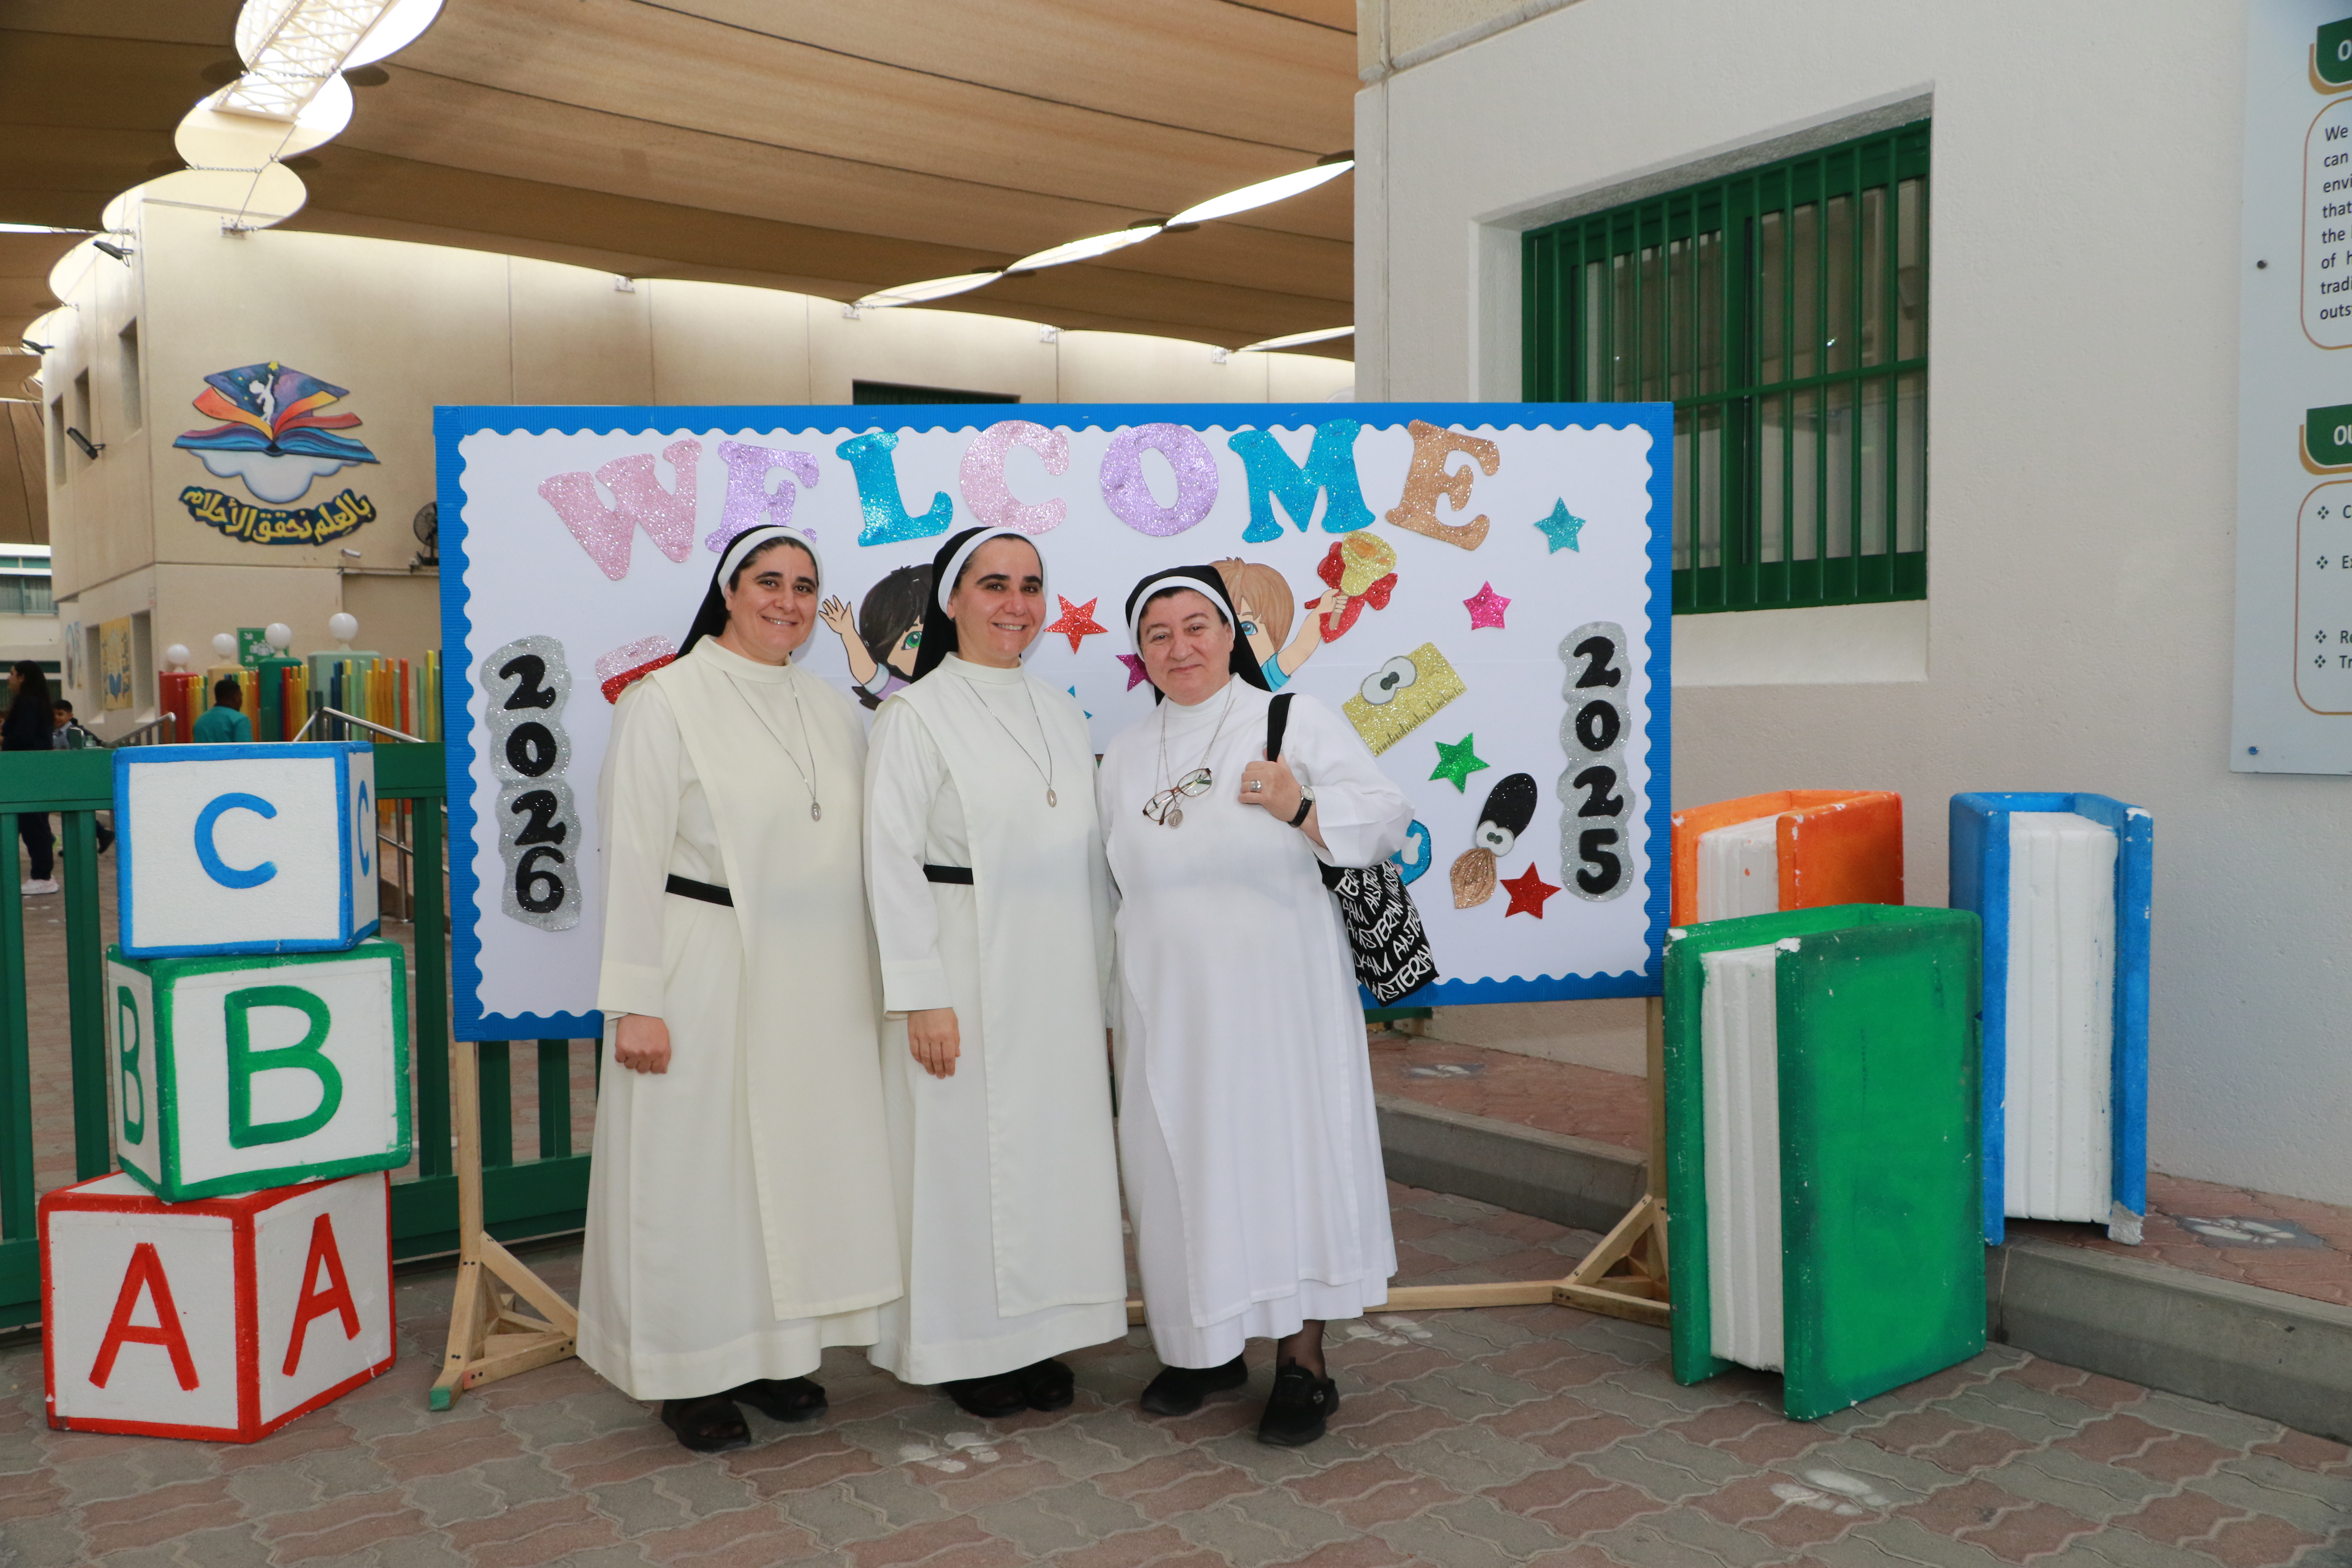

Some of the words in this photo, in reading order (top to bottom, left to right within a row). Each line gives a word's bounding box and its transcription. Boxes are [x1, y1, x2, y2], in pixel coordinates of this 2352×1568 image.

[2324, 152, 2349, 167] can
[2325, 125, 2348, 141] We
[2322, 200, 2352, 218] that
[2322, 228, 2345, 244] the
[2321, 253, 2336, 269] of
[2320, 304, 2352, 319] outs
[252, 510, 312, 543] نحقق
[538, 418, 1501, 581] WELCOME
[499, 654, 567, 913] 2026
[1574, 636, 1623, 894] 2025
[195, 792, 278, 889] C
[358, 780, 370, 877] C
[117, 986, 145, 1145] B
[225, 985, 343, 1150] B
[88, 1243, 200, 1391] A
[282, 1213, 361, 1377] A
